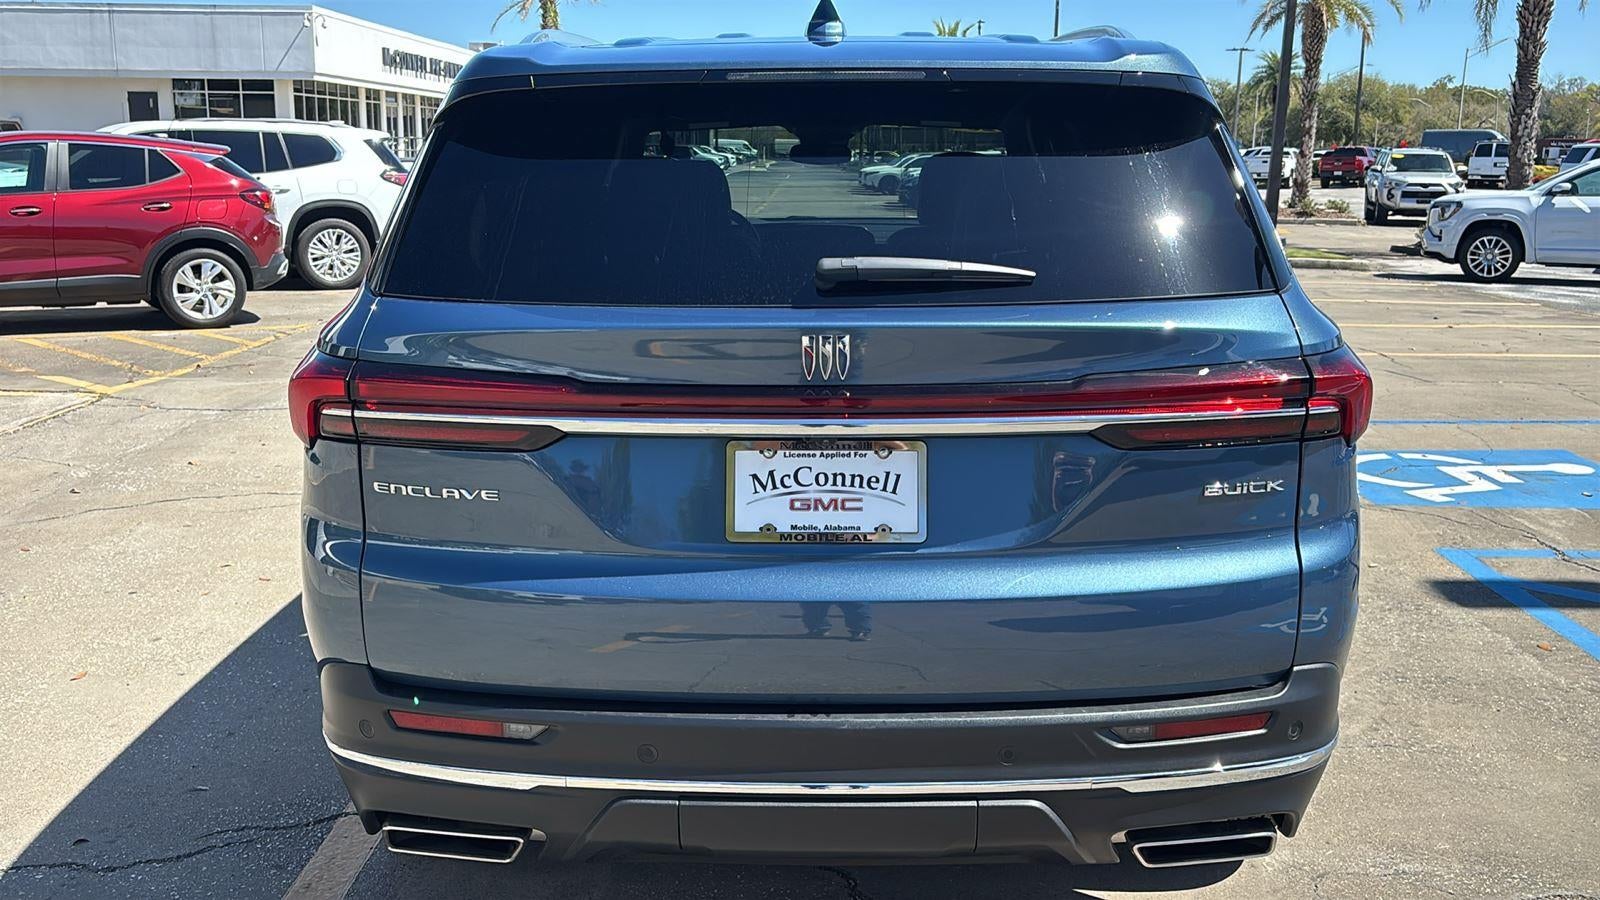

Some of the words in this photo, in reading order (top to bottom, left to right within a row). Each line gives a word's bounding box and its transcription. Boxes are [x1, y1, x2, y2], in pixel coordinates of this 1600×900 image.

[783, 451, 817, 459] License
[819, 451, 852, 460] Applied
[853, 451, 867, 459] For
[749, 466, 902, 496] McConnell
[1204, 479, 1285, 498] BUICK
[373, 481, 500, 502] ENCLAVE
[788, 497, 864, 512] GMC
[790, 524, 822, 533] Mobile,
[824, 524, 861, 532] Alabama
